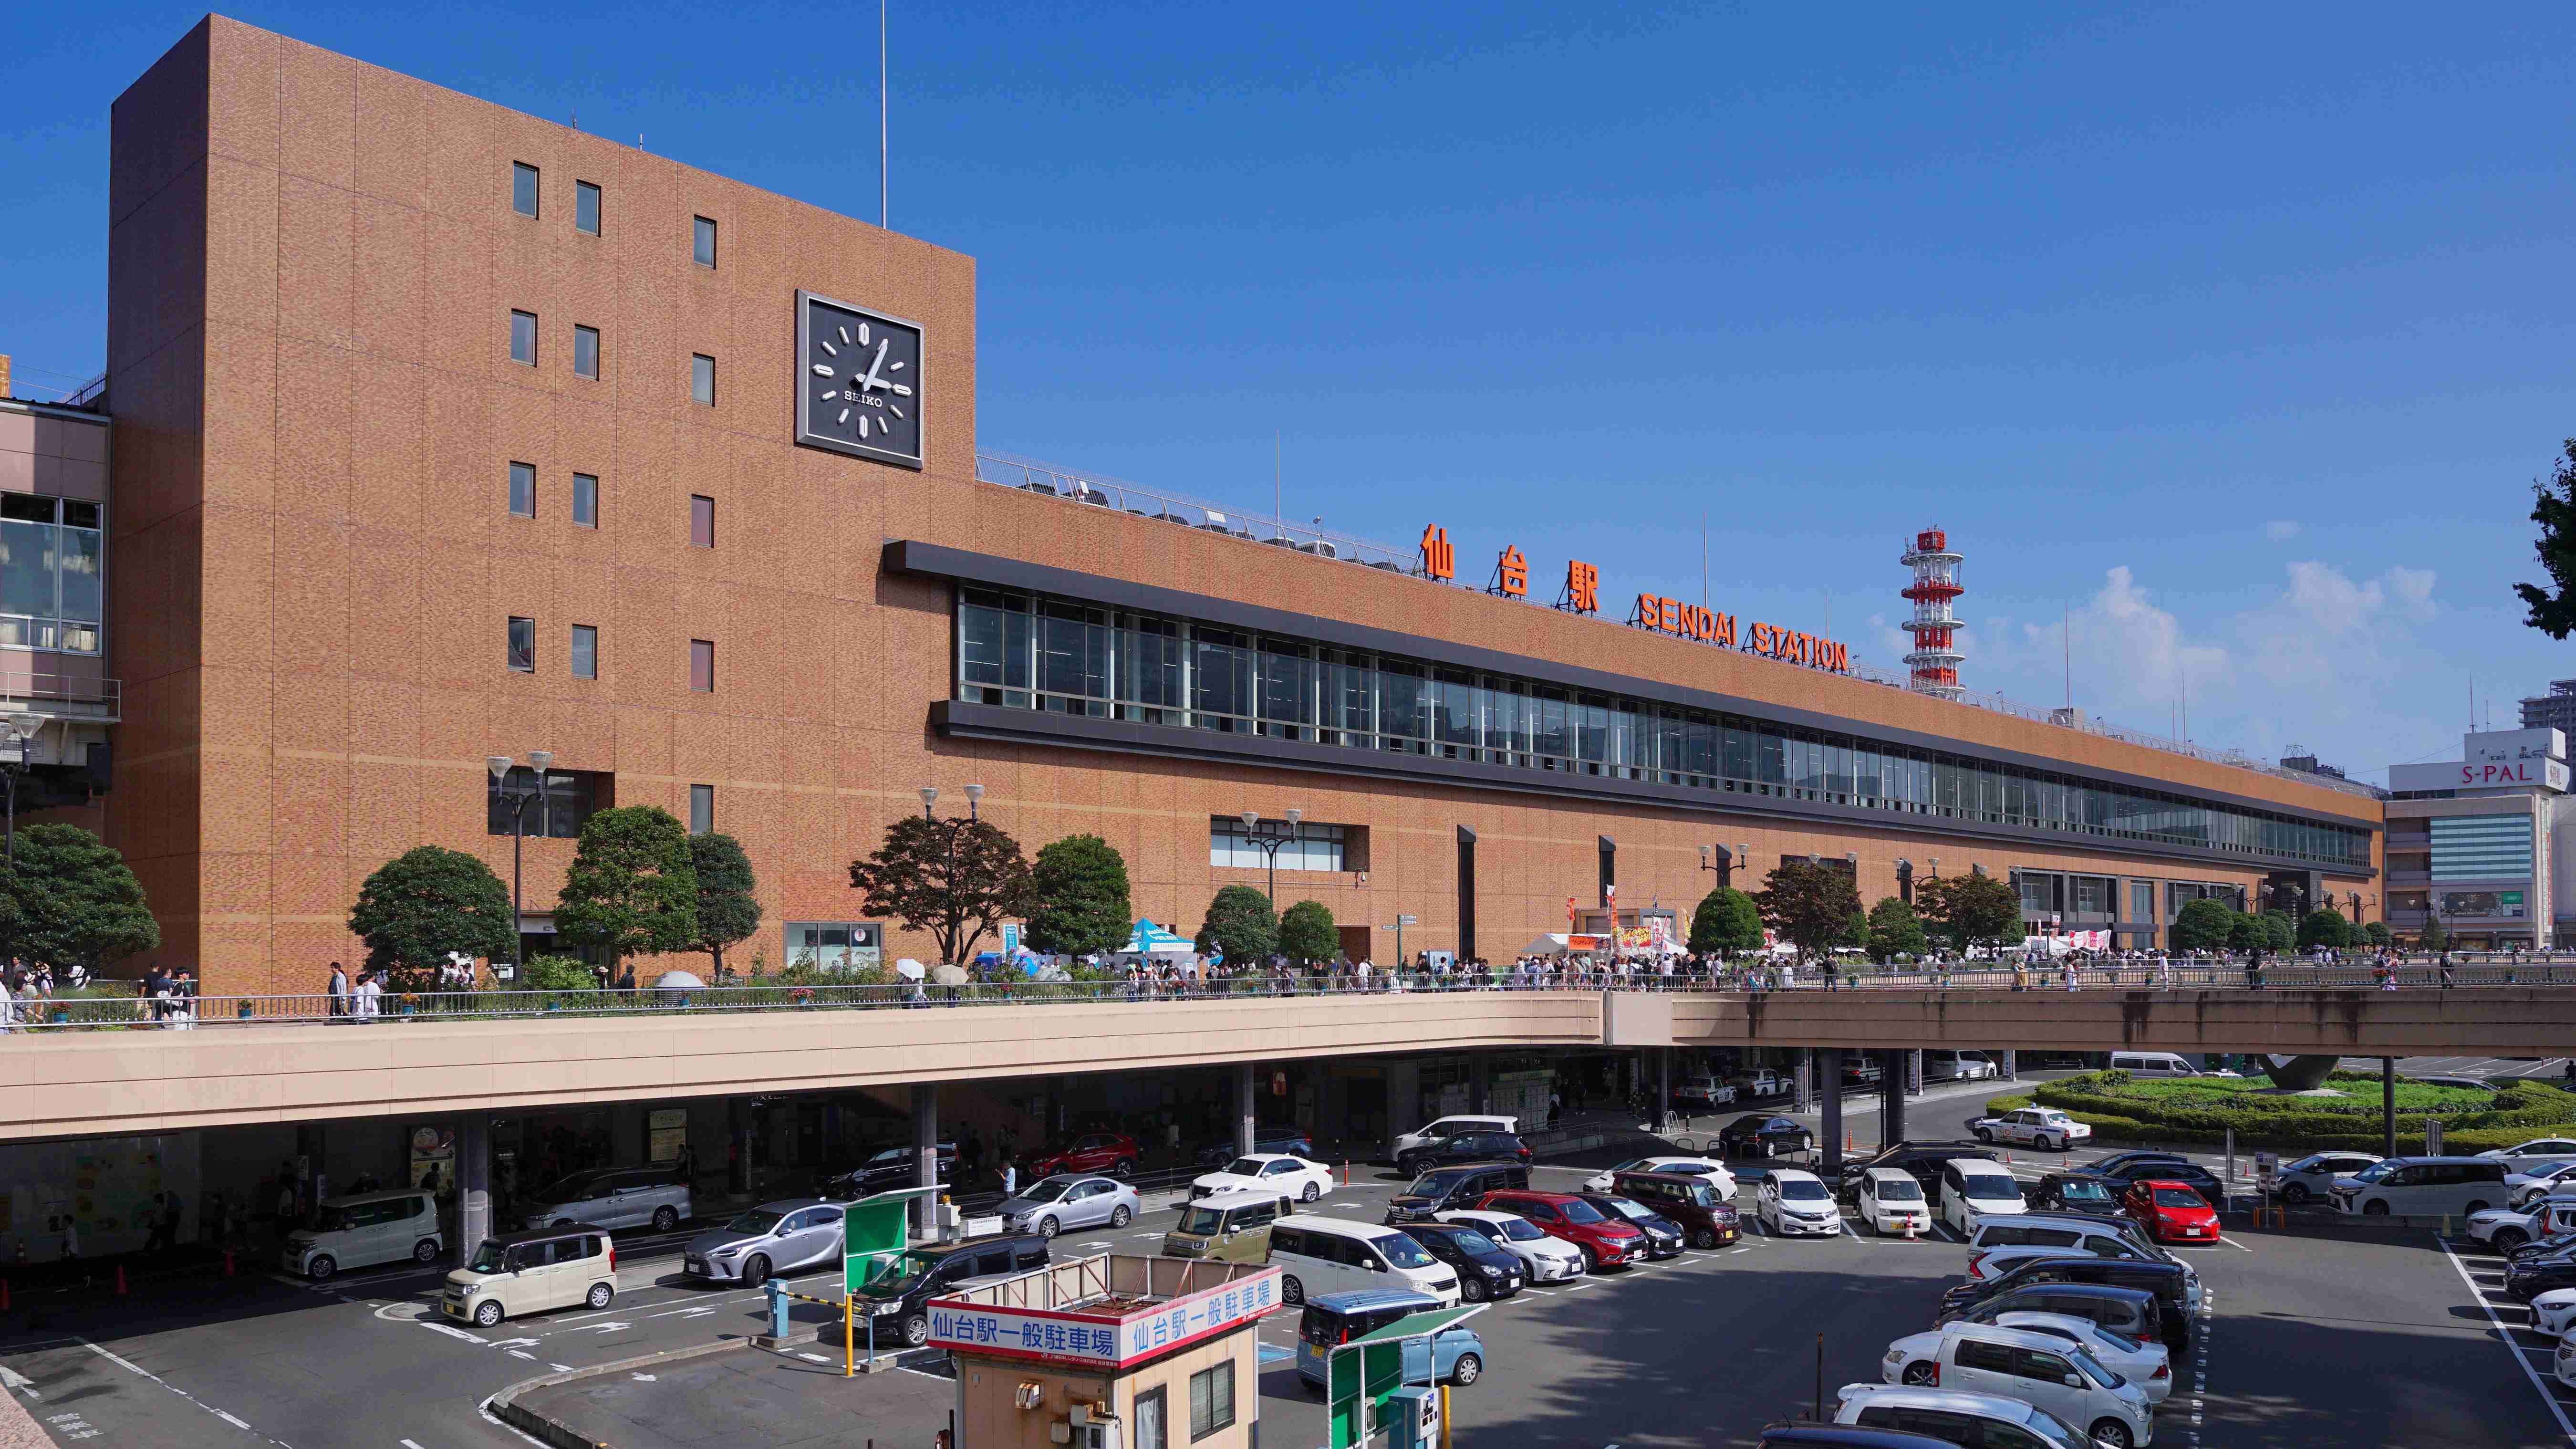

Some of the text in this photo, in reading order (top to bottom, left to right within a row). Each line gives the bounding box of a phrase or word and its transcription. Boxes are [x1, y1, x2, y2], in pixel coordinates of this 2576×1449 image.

[844, 390, 883, 408] SEIKO
[1420, 523, 1599, 612] 仙台駅
[1640, 593, 1847, 671] SENDAI STATION
[2462, 763, 2534, 783] S-PAL
[933, 1312, 1114, 1356] 仙台駅一般駐車場
[1133, 1279, 1270, 1354] 仙台駅一般駐車場
